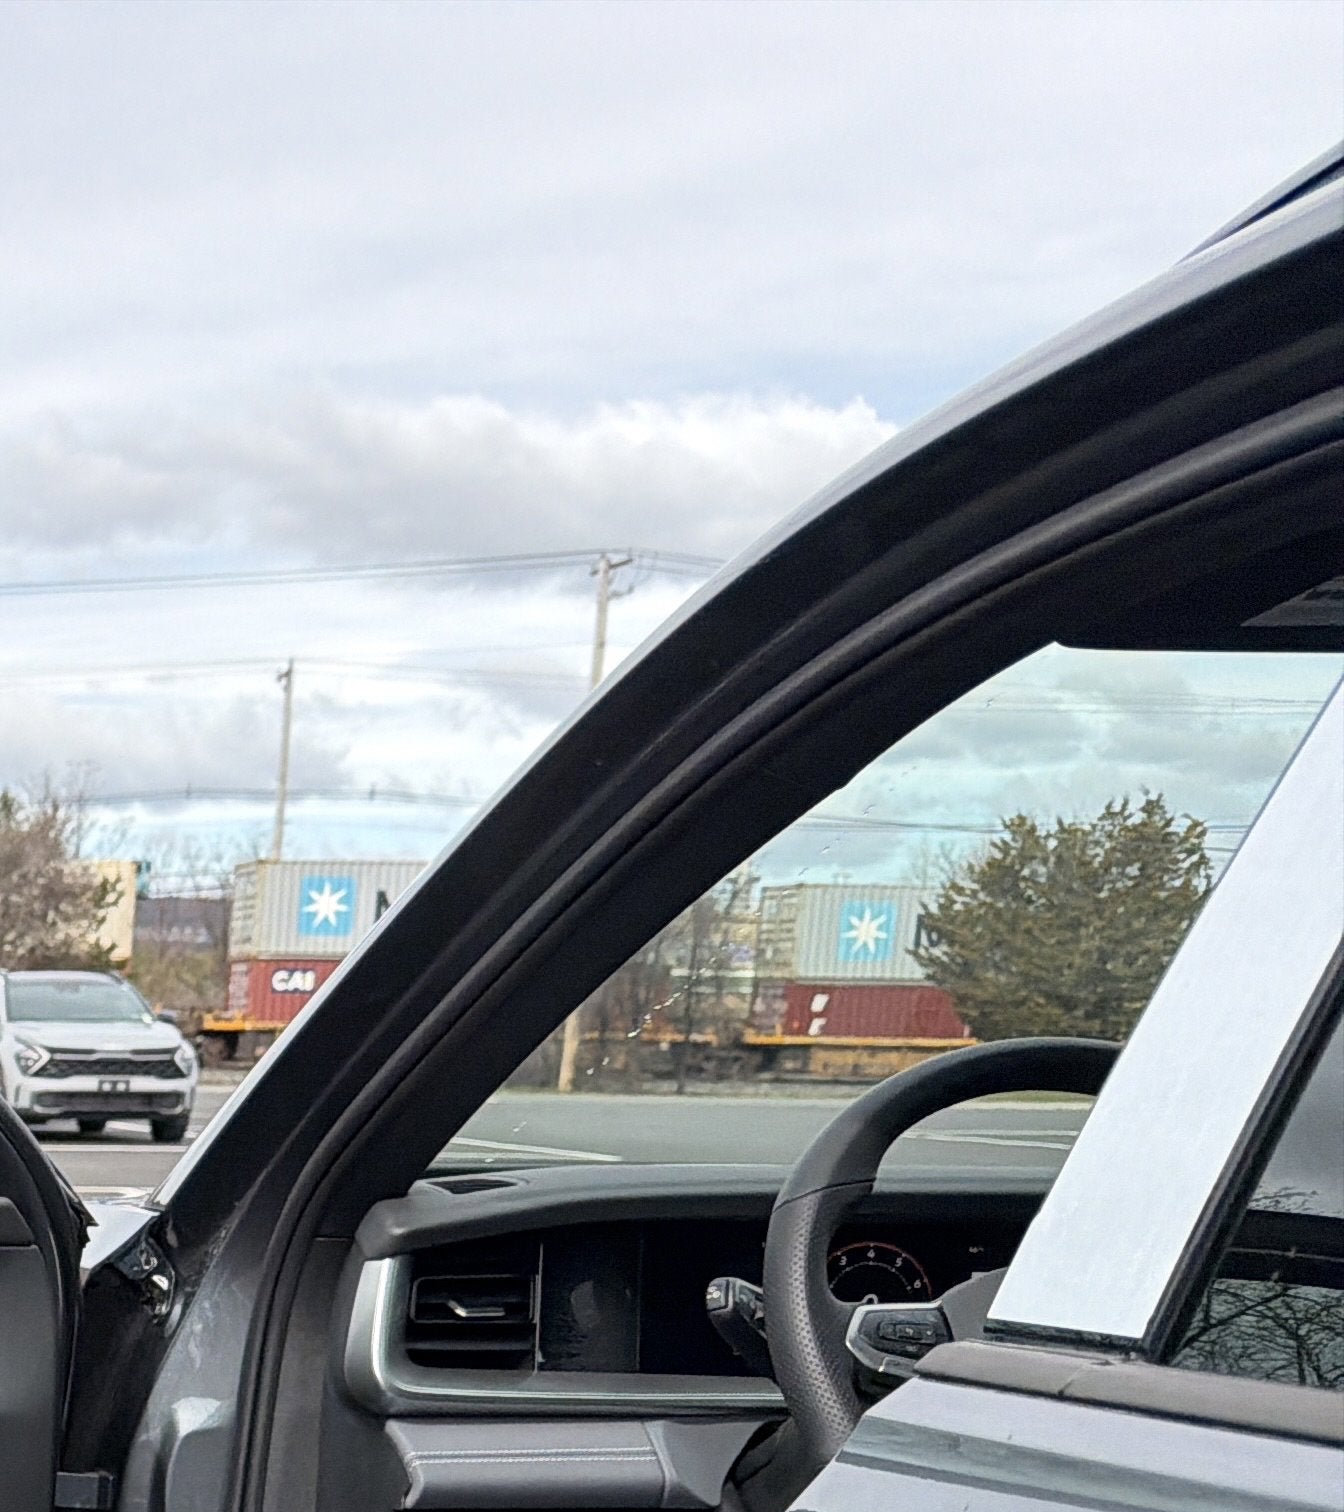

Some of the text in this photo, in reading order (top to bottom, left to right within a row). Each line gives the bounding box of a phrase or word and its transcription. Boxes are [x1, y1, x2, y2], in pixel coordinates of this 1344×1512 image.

[272, 970, 316, 991] CAI
[867, 1249, 876, 1259] 4
[839, 1255, 848, 1266] 3
[894, 1257, 903, 1268] 5
[913, 1279, 922, 1289] 6
